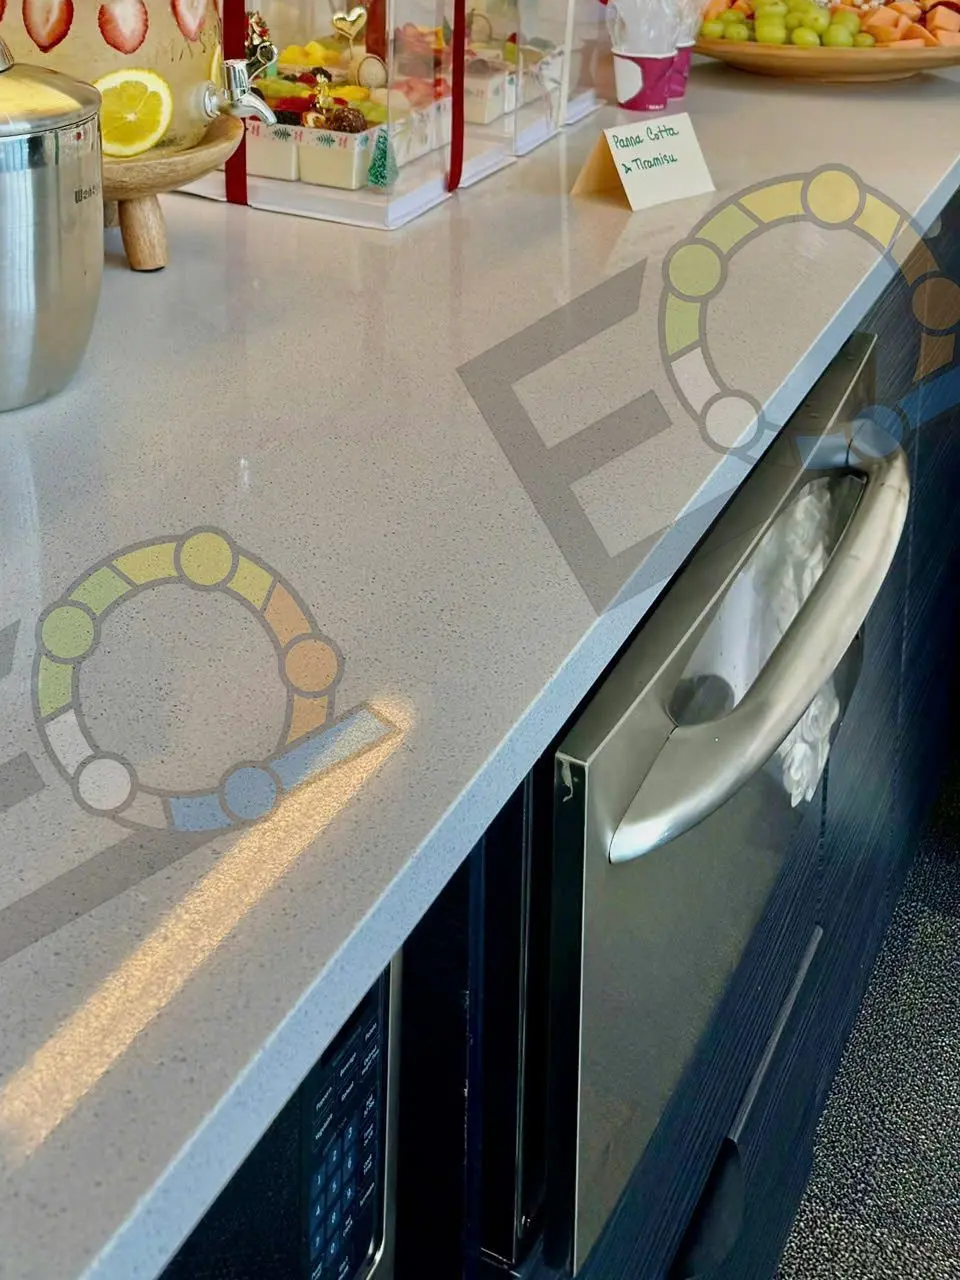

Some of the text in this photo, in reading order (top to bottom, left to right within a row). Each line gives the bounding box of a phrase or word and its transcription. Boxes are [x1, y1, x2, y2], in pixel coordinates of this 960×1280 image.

[612, 125, 679, 149] Panna Cotta
[631, 153, 678, 170] Tiramisu
